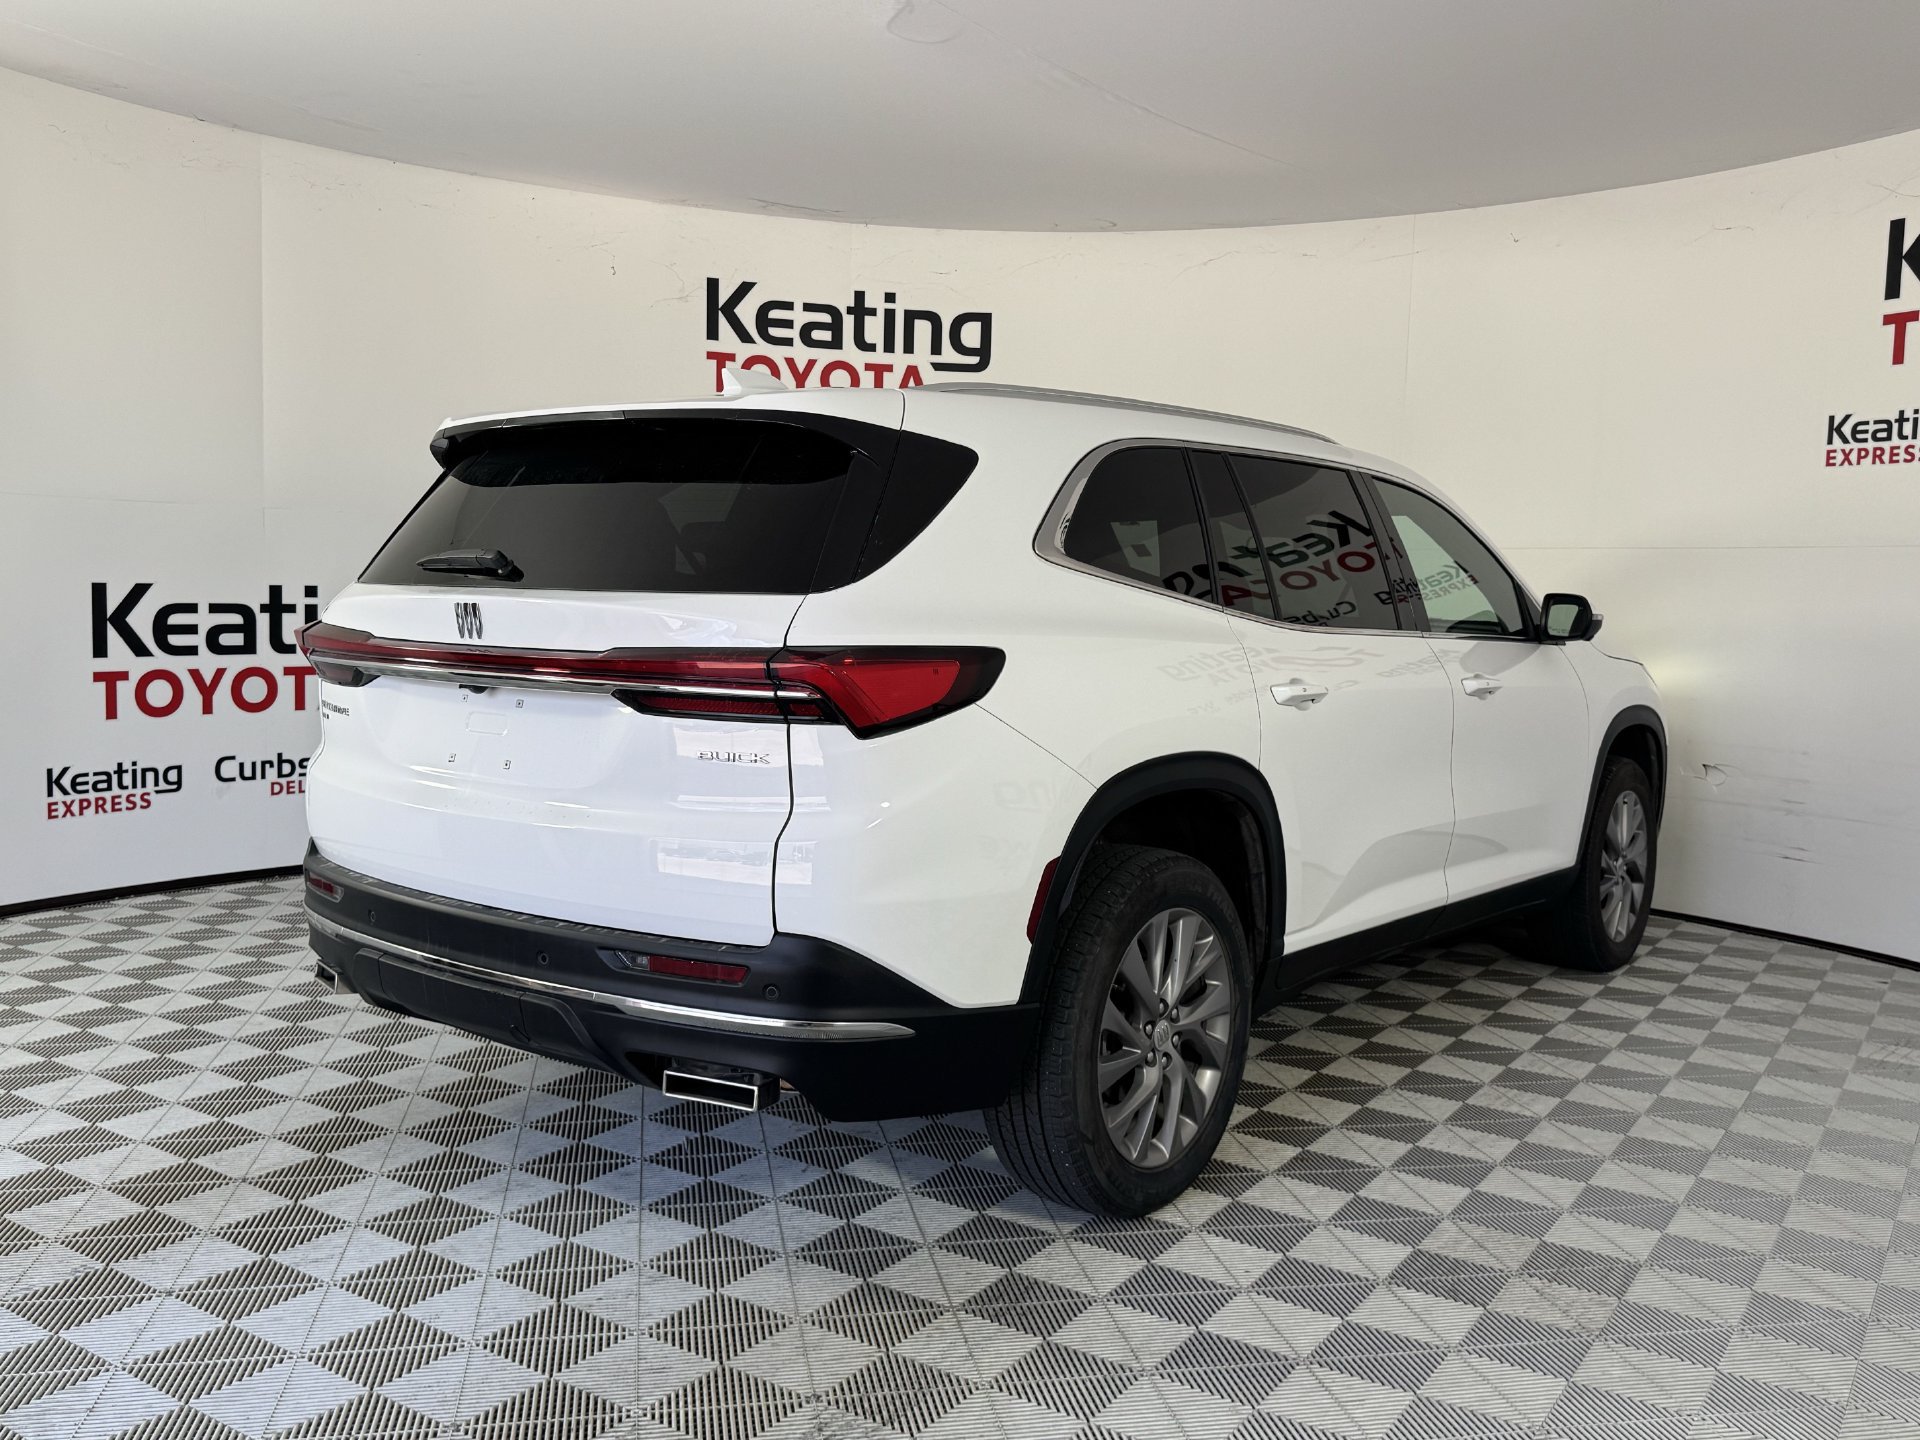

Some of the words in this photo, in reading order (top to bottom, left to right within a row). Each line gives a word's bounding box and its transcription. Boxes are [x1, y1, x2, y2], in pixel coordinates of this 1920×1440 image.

[706, 276, 992, 372] Keating
[1826, 408, 1920, 446] Keati
[1824, 443, 1920, 468] EXPRES
[93, 666, 320, 721] TOYOT
[697, 750, 771, 765] BUICK
[46, 760, 183, 798] Keating
[269, 778, 307, 796] DEL
[46, 791, 153, 820] EXPRESS
